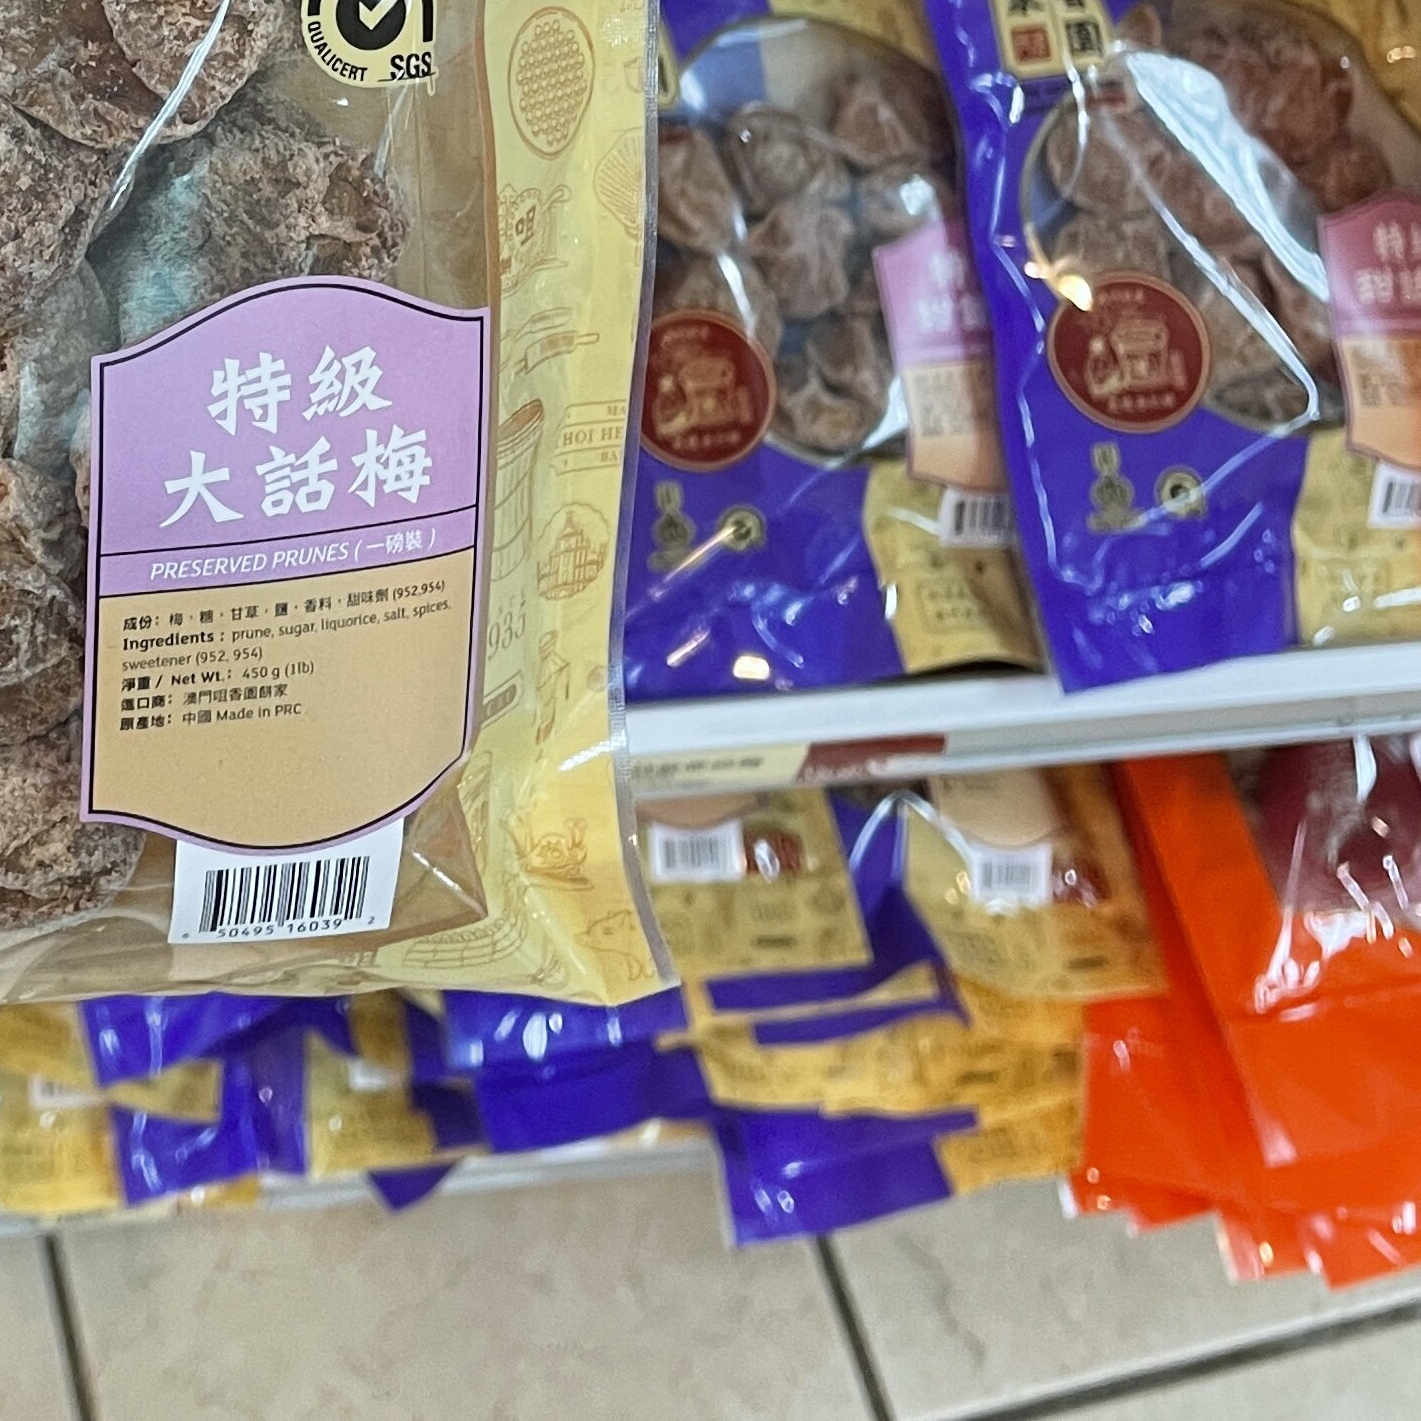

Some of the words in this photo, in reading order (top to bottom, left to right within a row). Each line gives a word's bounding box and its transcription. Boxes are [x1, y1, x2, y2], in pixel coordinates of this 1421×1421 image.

[307, 21, 368, 82] QUALICERT
[390, 51, 432, 81] SGS
[207, 345, 393, 436] 特級
[160, 424, 433, 528] 大話梅
[151, 553, 267, 580] PRESERVED
[271, 542, 349, 570] PRUNES
[123, 631, 214, 652] Ingredients
[232, 626, 274, 643] prune,
[321, 613, 381, 632] liquorice,
[122, 653, 191, 672] sweetener
[233, 646, 264, 662] 954)
[171, 672, 196, 686] Net
[242, 665, 268, 680] 450
[272, 667, 280, 680] g
[216, 707, 254, 721] Made
[258, 705, 266, 718] in
[274, 703, 302, 717] PRC
[216, 925, 275, 939] 50495
[287, 920, 343, 934] 16039
[367, 916, 376, 925] 2
